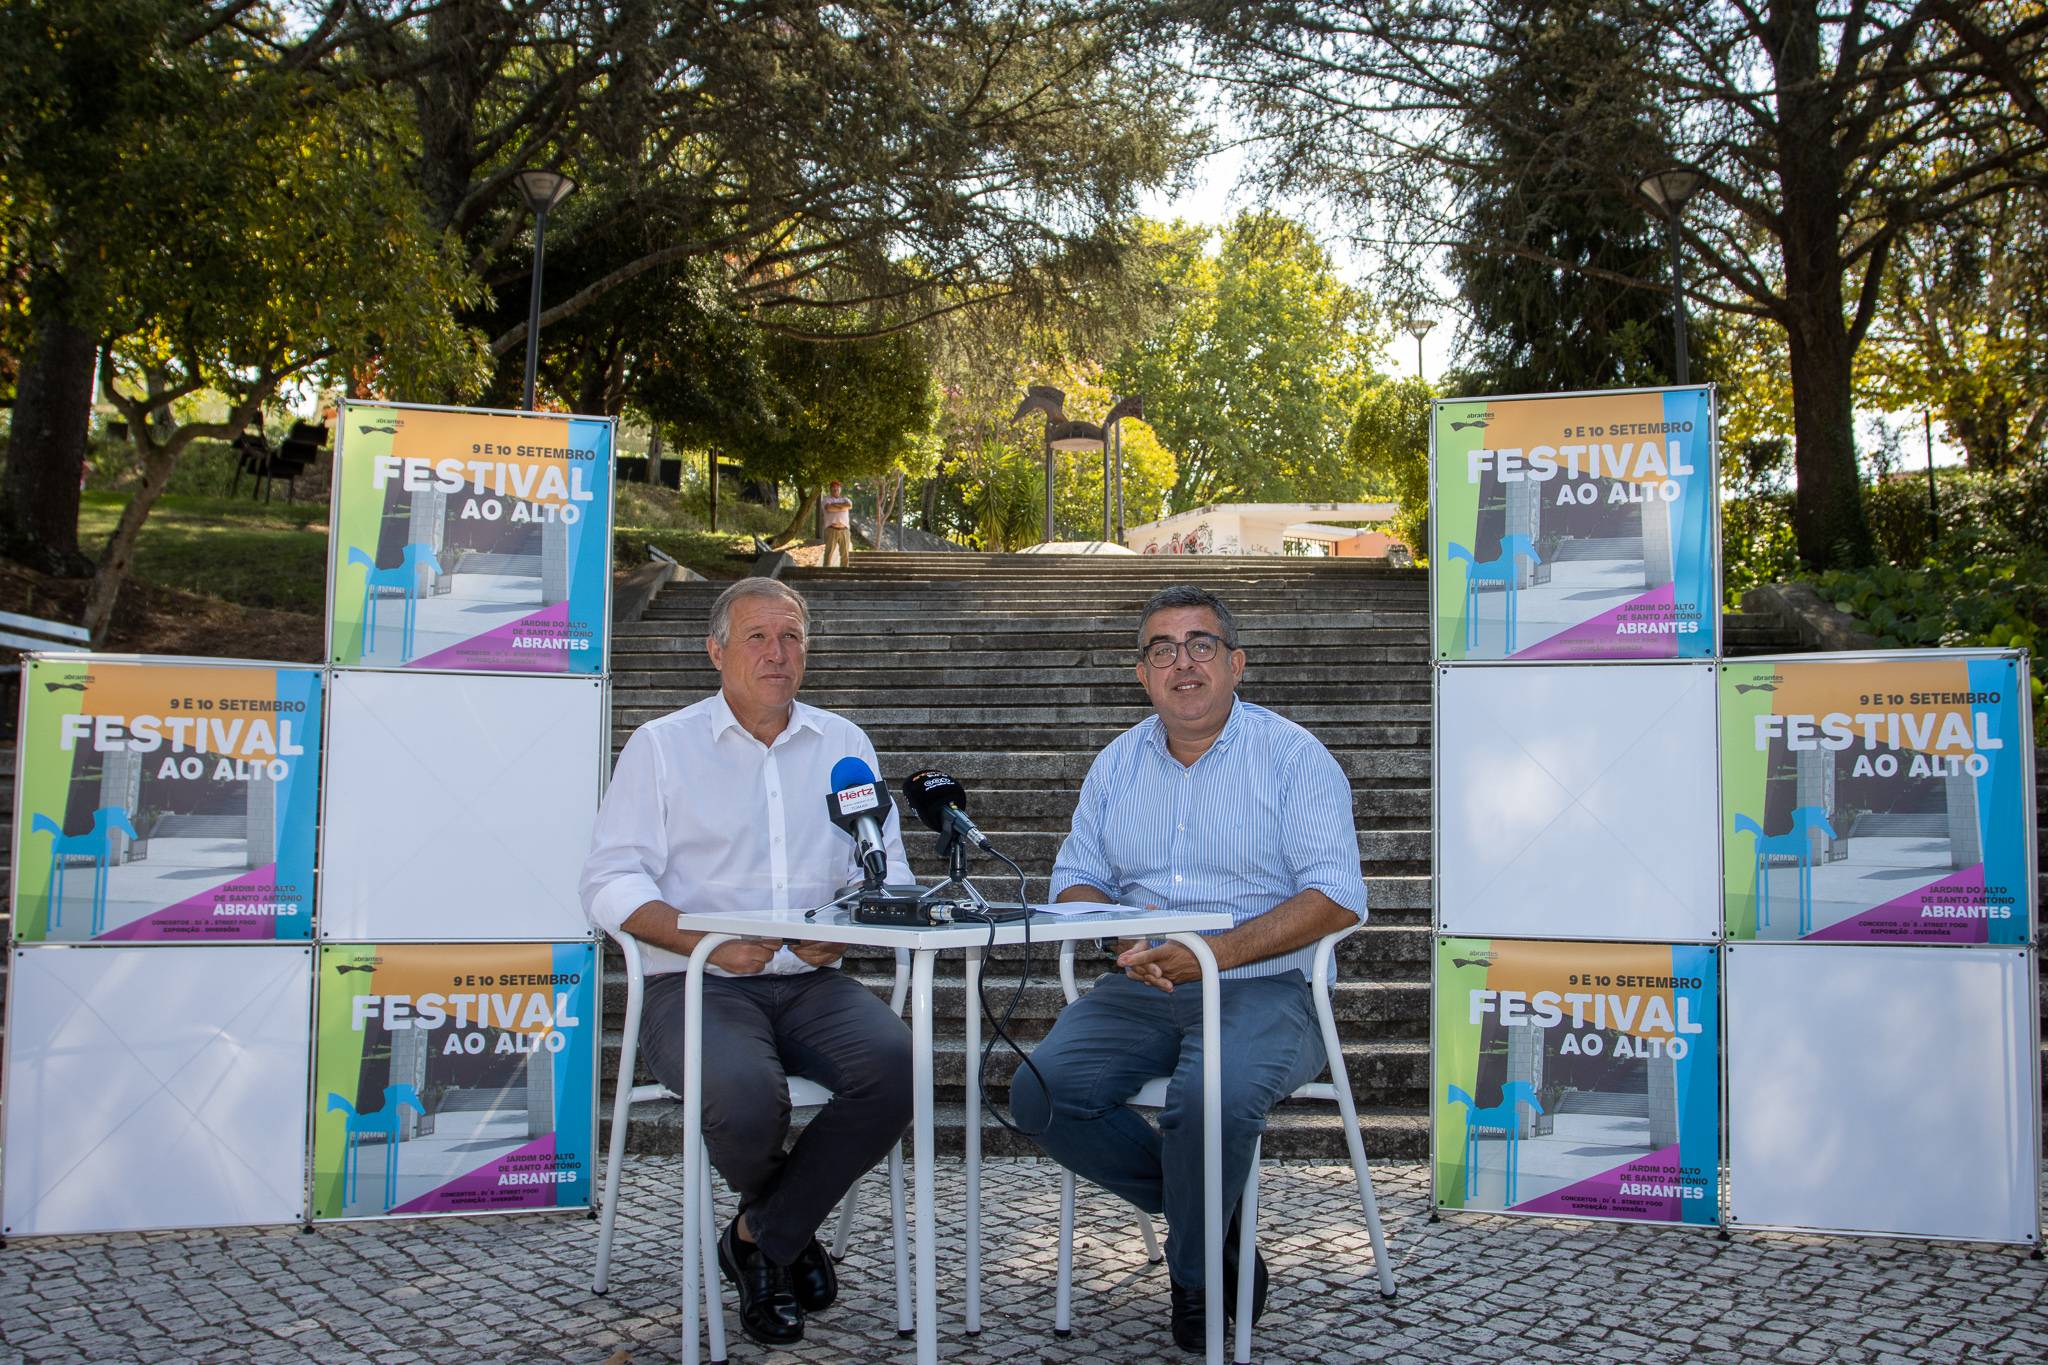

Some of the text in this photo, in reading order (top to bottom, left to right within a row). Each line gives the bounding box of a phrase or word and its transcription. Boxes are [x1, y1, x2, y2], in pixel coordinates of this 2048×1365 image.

[1564, 421, 1693, 438] 9 E 10 SETEMBRO
[472, 444, 596, 461] 9 E 10 SETEMBRO
[1467, 440, 1694, 484] FESTIVAL
[372, 456, 593, 501] FESTIVAL
[1556, 480, 1681, 506] AO ALTO
[461, 499, 580, 525] AO ALTO
[1663, 612, 1702, 620] ANTÓNIO
[557, 629, 593, 637] ANTÓNIO
[1616, 621, 1699, 634] ABRANTES
[512, 637, 589, 650] ABRANTES
[171, 699, 306, 712] 9 E 10 SETEMBRO
[1860, 692, 2001, 705] 9 E 10 SETEMBRO
[60, 714, 304, 756] FESTIVAL
[1754, 712, 2004, 752] FESTIVAL
[157, 757, 288, 781] AO ALTO
[1852, 754, 1989, 777] AO ALTO
[839, 788, 874, 801] Hertz
[1984, 886, 2007, 894] ALTO
[262, 894, 302, 902] ANTÓNIO
[1972, 894, 2015, 904] ANTÓNIO
[213, 904, 297, 916] ABRANTES
[1921, 905, 2011, 918] ABRANTES
[454, 974, 581, 986] 9 E 10 SETEMBRO
[1570, 975, 1702, 989] 9 E 10 SETEMBRO
[352, 992, 579, 1030] FESTIVAL
[1469, 990, 1703, 1034] FESTIVAL
[443, 1033, 566, 1056] AO ALTO
[1560, 1033, 1688, 1060] AO ALTO
[544, 1162, 581, 1170] ANTÓNIO
[498, 1171, 576, 1186] ABRANTES
[1668, 1176, 1708, 1185] ANTÓNIO
[1620, 1183, 1704, 1199] ABRANTES
